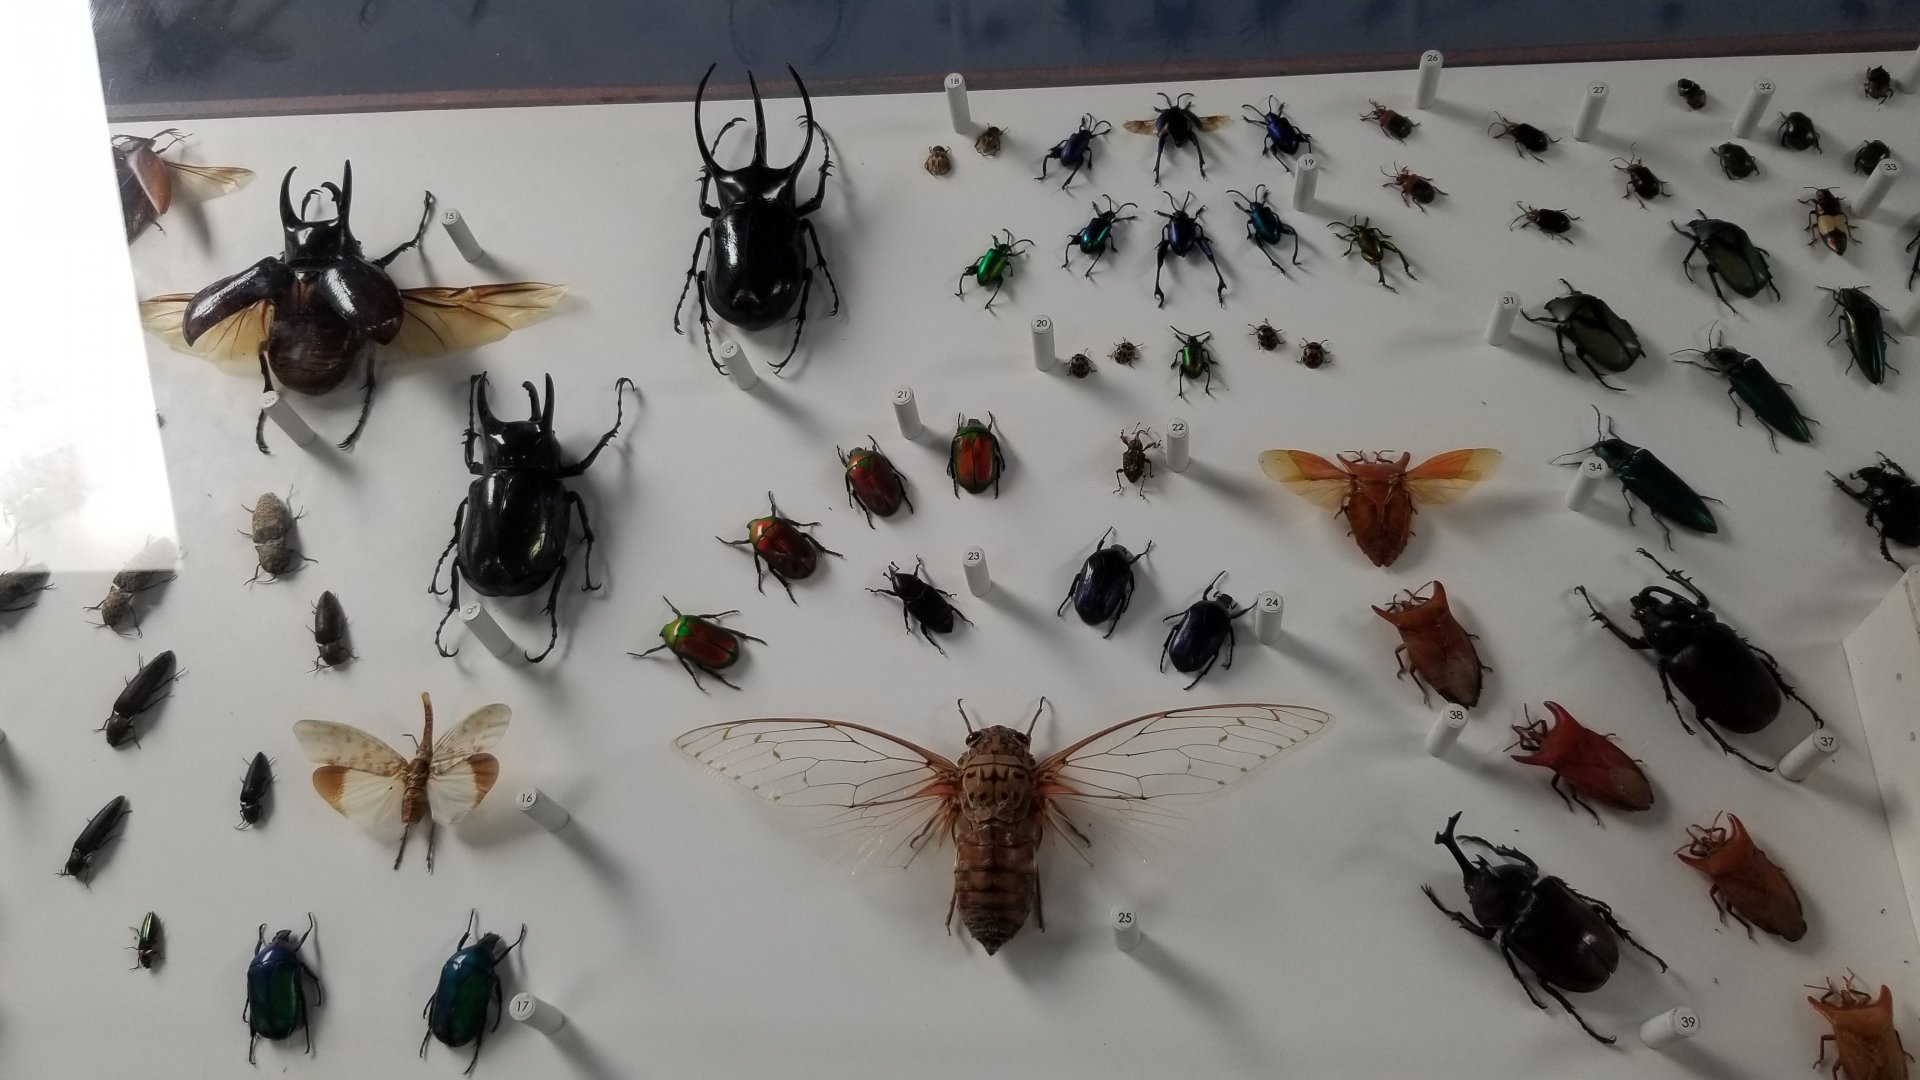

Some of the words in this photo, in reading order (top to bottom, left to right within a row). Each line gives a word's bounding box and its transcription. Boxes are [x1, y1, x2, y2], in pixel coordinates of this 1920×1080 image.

[1427, 54, 1438, 62] 26
[950, 77, 960, 85] 18
[1594, 86, 1605, 94] 27
[1304, 158, 1314, 166] 19
[1884, 163, 1897, 171] 33
[445, 212, 455, 220] 15
[1503, 296, 1514, 304] 31
[1036, 319, 1047, 327] 20
[897, 390, 907, 399] 21
[1172, 423, 1184, 432] 22
[1589, 462, 1602, 471] 34
[968, 552, 980, 561] 23
[1266, 598, 1279, 607] 24
[1449, 710, 1463, 720] 38
[1820, 736, 1834, 747] 37
[521, 793, 532, 803] 16
[1118, 912, 1132, 923] 25
[516, 1001, 529, 1012] 17
[1681, 1016, 1696, 1028] 39
